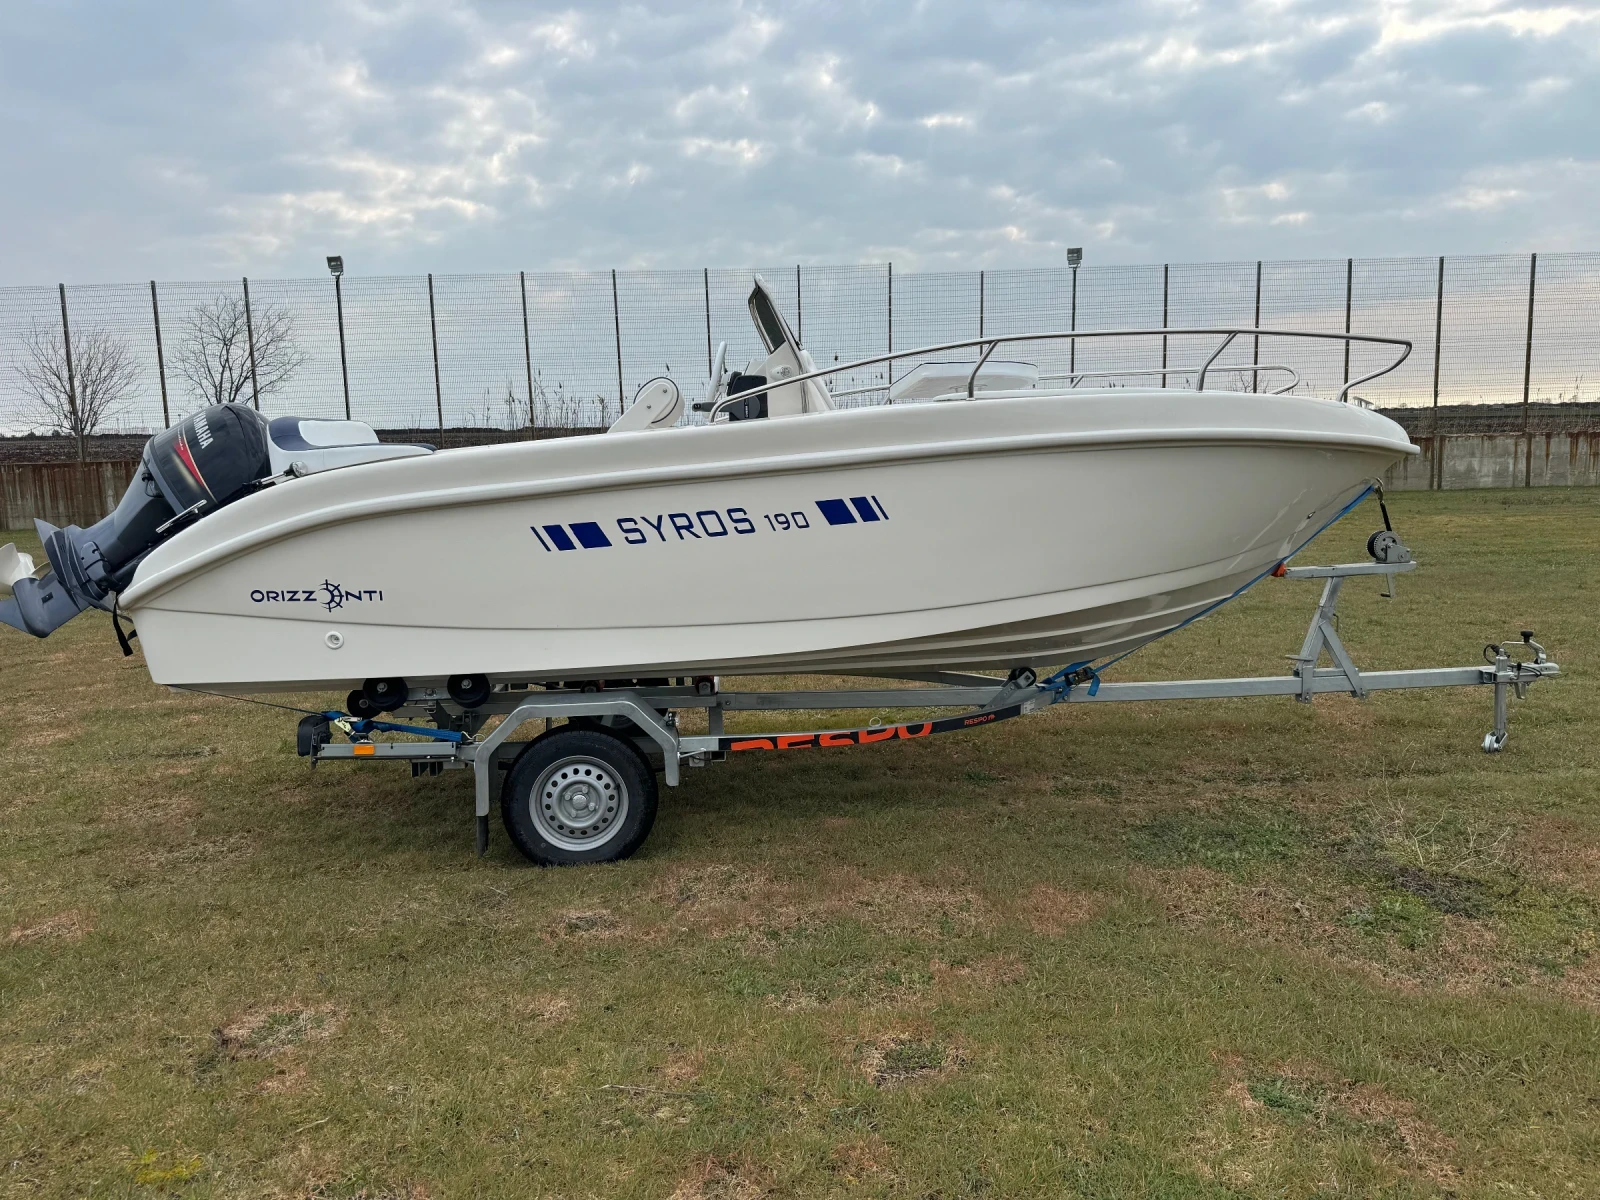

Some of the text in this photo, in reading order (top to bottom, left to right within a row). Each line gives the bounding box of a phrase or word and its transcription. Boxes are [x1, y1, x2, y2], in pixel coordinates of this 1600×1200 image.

[193, 410, 214, 450] YAMAHA
[616, 507, 810, 545] SYROS 190
[964, 715, 987, 726] RESPO
